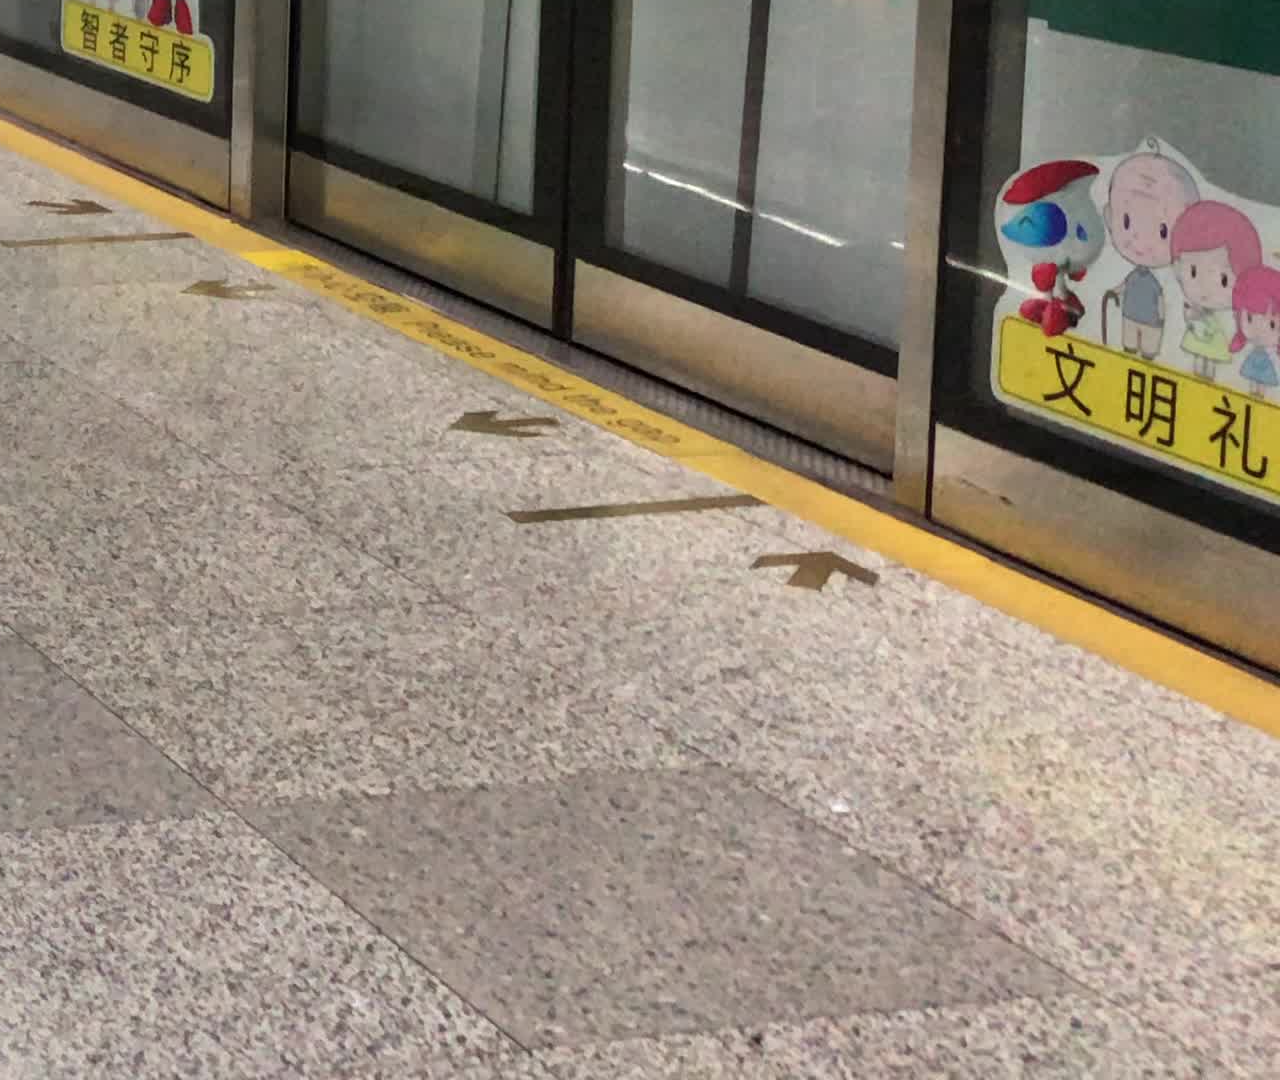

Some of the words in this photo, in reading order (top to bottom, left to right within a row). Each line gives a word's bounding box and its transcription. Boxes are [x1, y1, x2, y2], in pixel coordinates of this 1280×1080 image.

[78, 7, 193, 86] 智者守序
[1042, 342, 1269, 479] 文明礼
